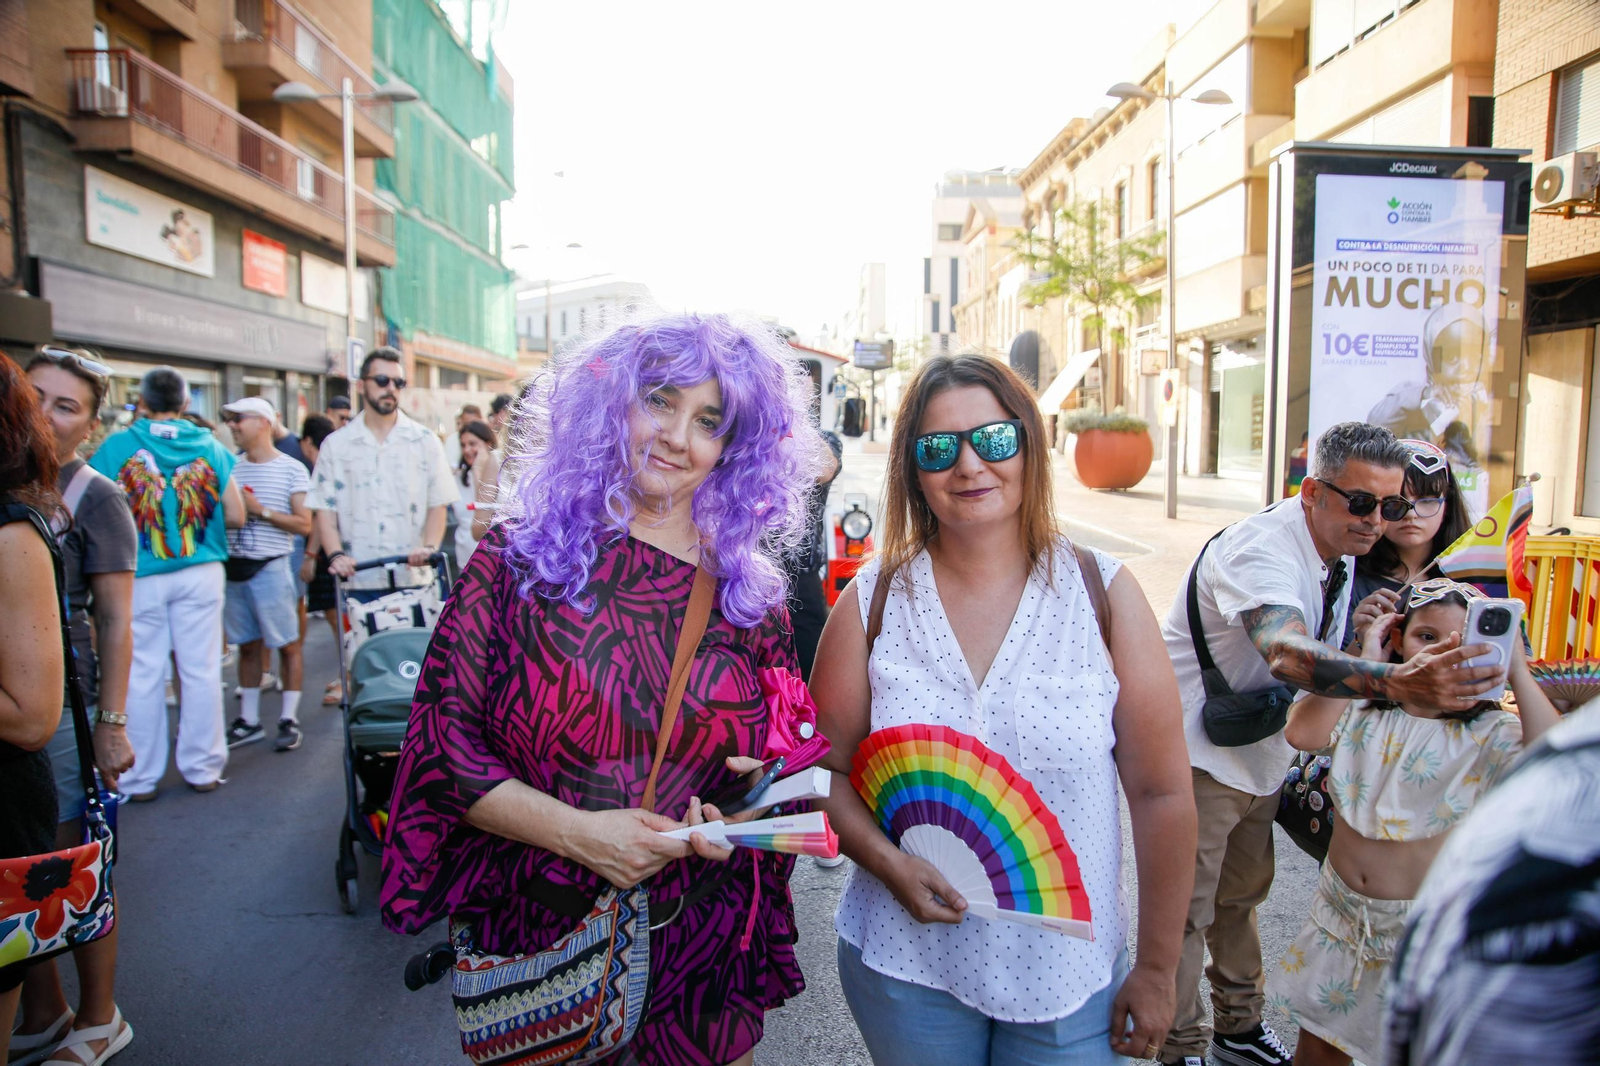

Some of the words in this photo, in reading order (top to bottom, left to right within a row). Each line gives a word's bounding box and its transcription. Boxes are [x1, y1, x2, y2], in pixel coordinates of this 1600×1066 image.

[1389, 161, 1437, 174] JCDecaux
[1402, 200, 1432, 210] ACCIÓN
[1401, 215, 1431, 223] HAMBRE
[1338, 241, 1371, 250] CONTRA
[1372, 241, 1382, 250] LA
[1383, 240, 1440, 252] DESNUTRICIÓN
[1442, 244, 1476, 253] INFANTIL
[1328, 260, 1348, 271] UN
[1353, 261, 1392, 273] POCO
[1397, 263, 1413, 273] DE
[1416, 263, 1427, 274] TI
[1432, 263, 1449, 275] DA
[1453, 264, 1485, 276] PARA
[1324, 275, 1487, 310] MUCHO
[1322, 322, 1340, 330] CON
[1322, 333, 1370, 356] 10€
[1374, 335, 1417, 343] TRATAMIENTO
[1322, 358, 1352, 366] DURANTE
